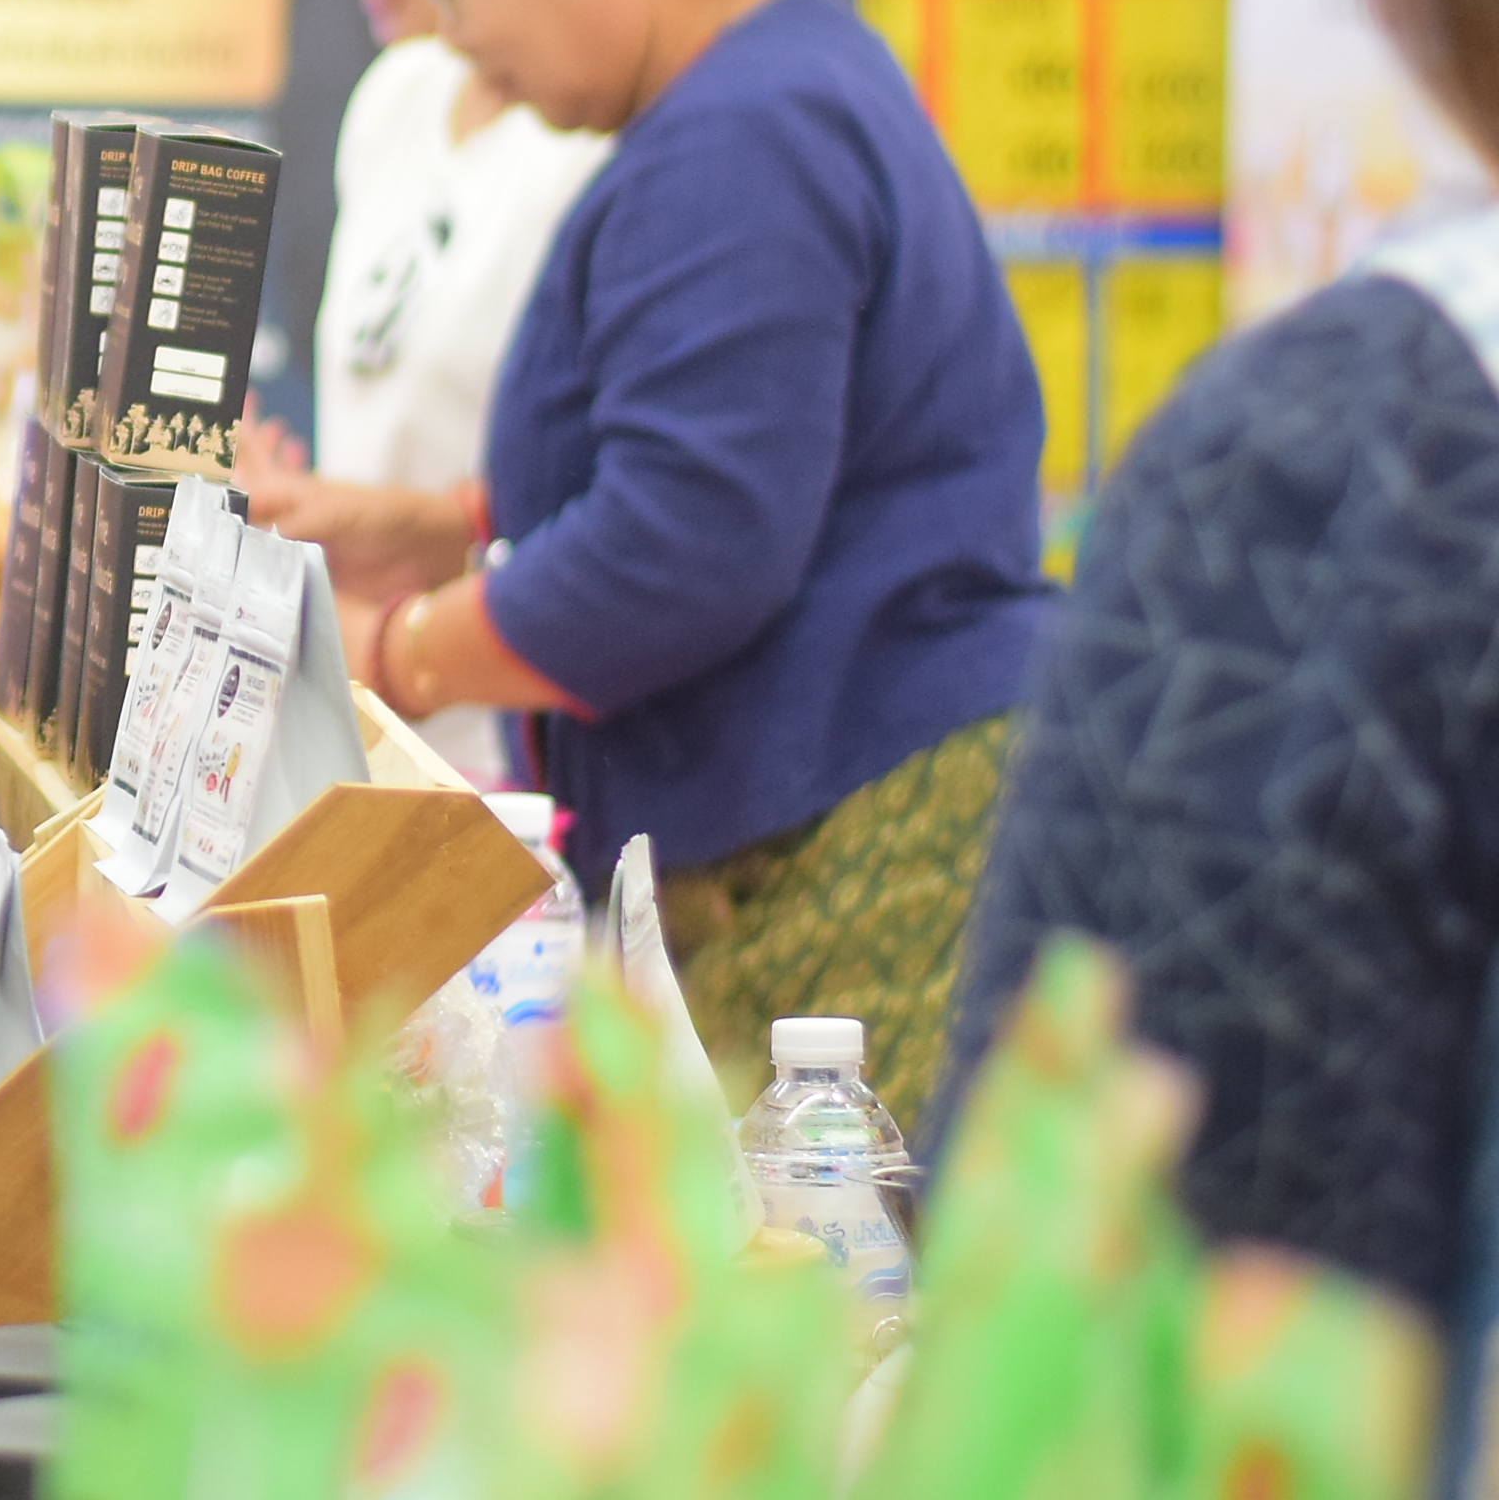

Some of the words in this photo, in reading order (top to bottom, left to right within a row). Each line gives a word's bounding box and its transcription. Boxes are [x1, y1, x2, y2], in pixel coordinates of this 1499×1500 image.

[100, 150, 127, 162] DRIP
[171, 159, 198, 173] DRIP
[200, 164, 224, 178] BAG
[226, 168, 267, 185] COFFEE
[138, 505, 165, 518] DRIP
